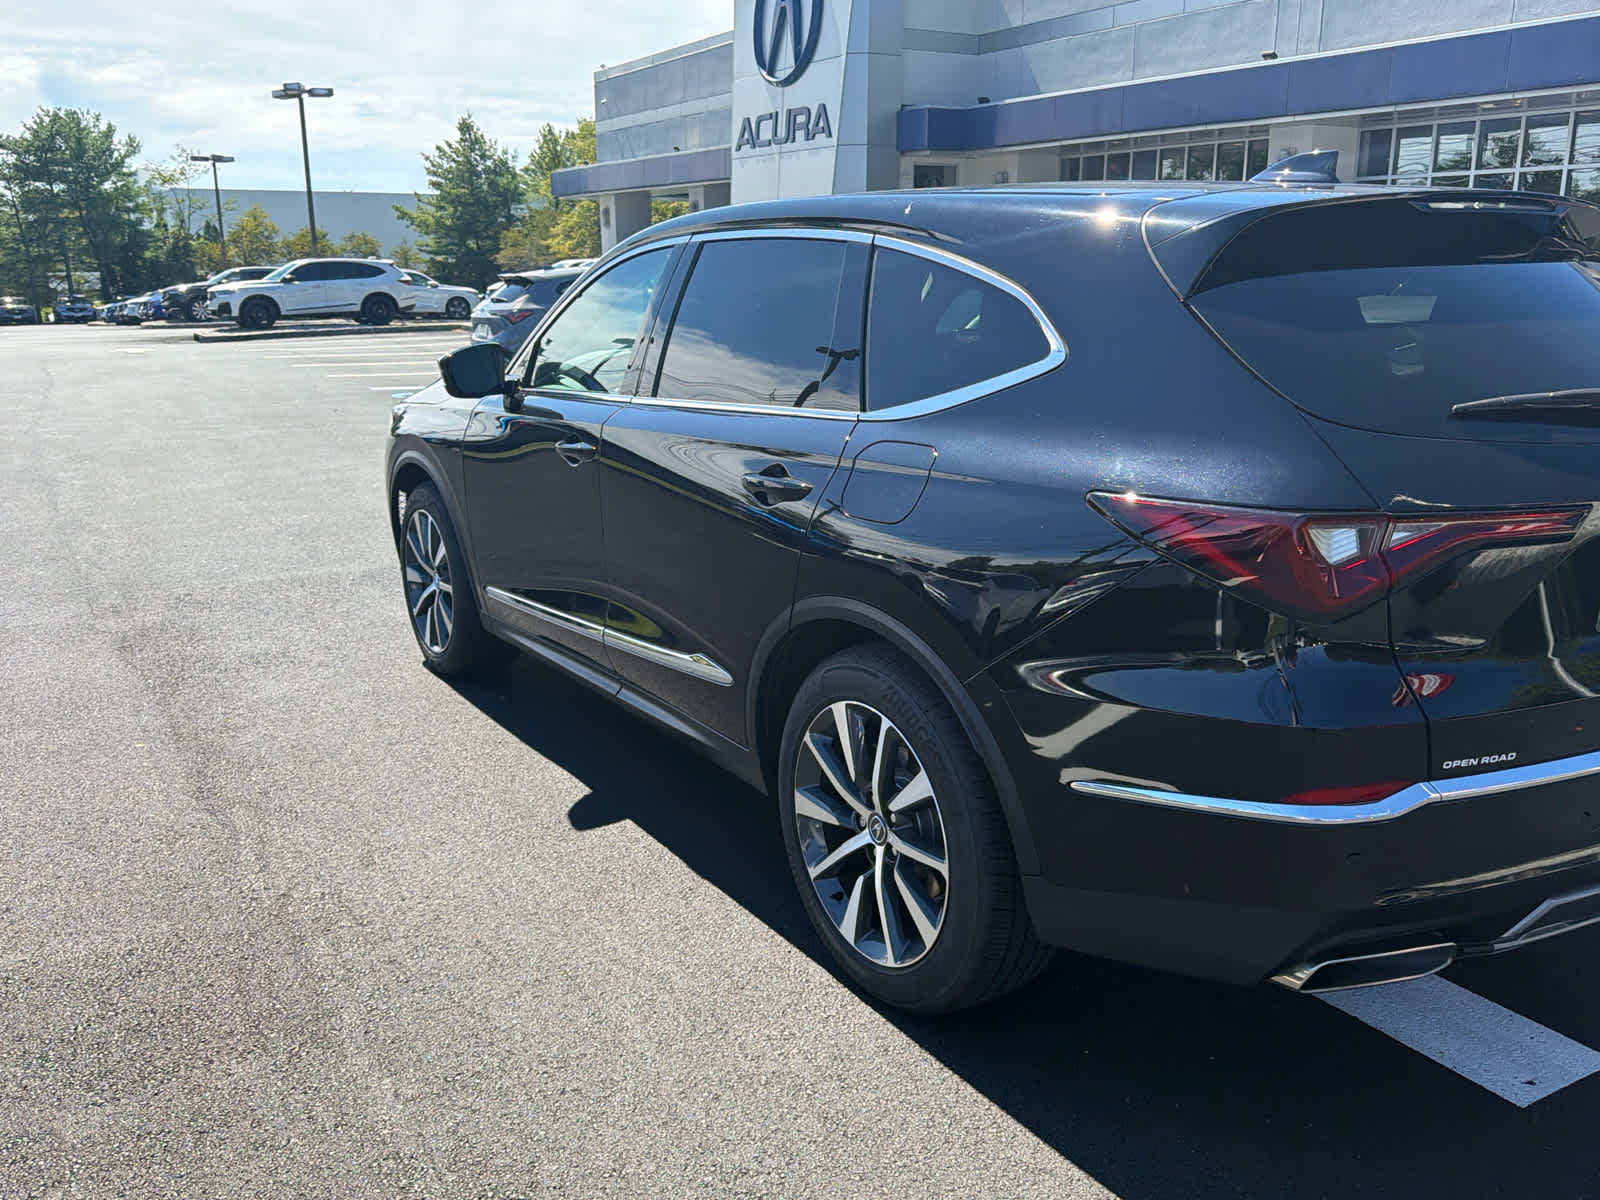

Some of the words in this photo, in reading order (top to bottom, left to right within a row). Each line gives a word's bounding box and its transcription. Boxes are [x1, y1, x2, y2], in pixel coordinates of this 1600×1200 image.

[735, 103, 832, 152] ACURA
[1442, 758, 1479, 769] OPEN
[1480, 752, 1517, 765] ROAD
